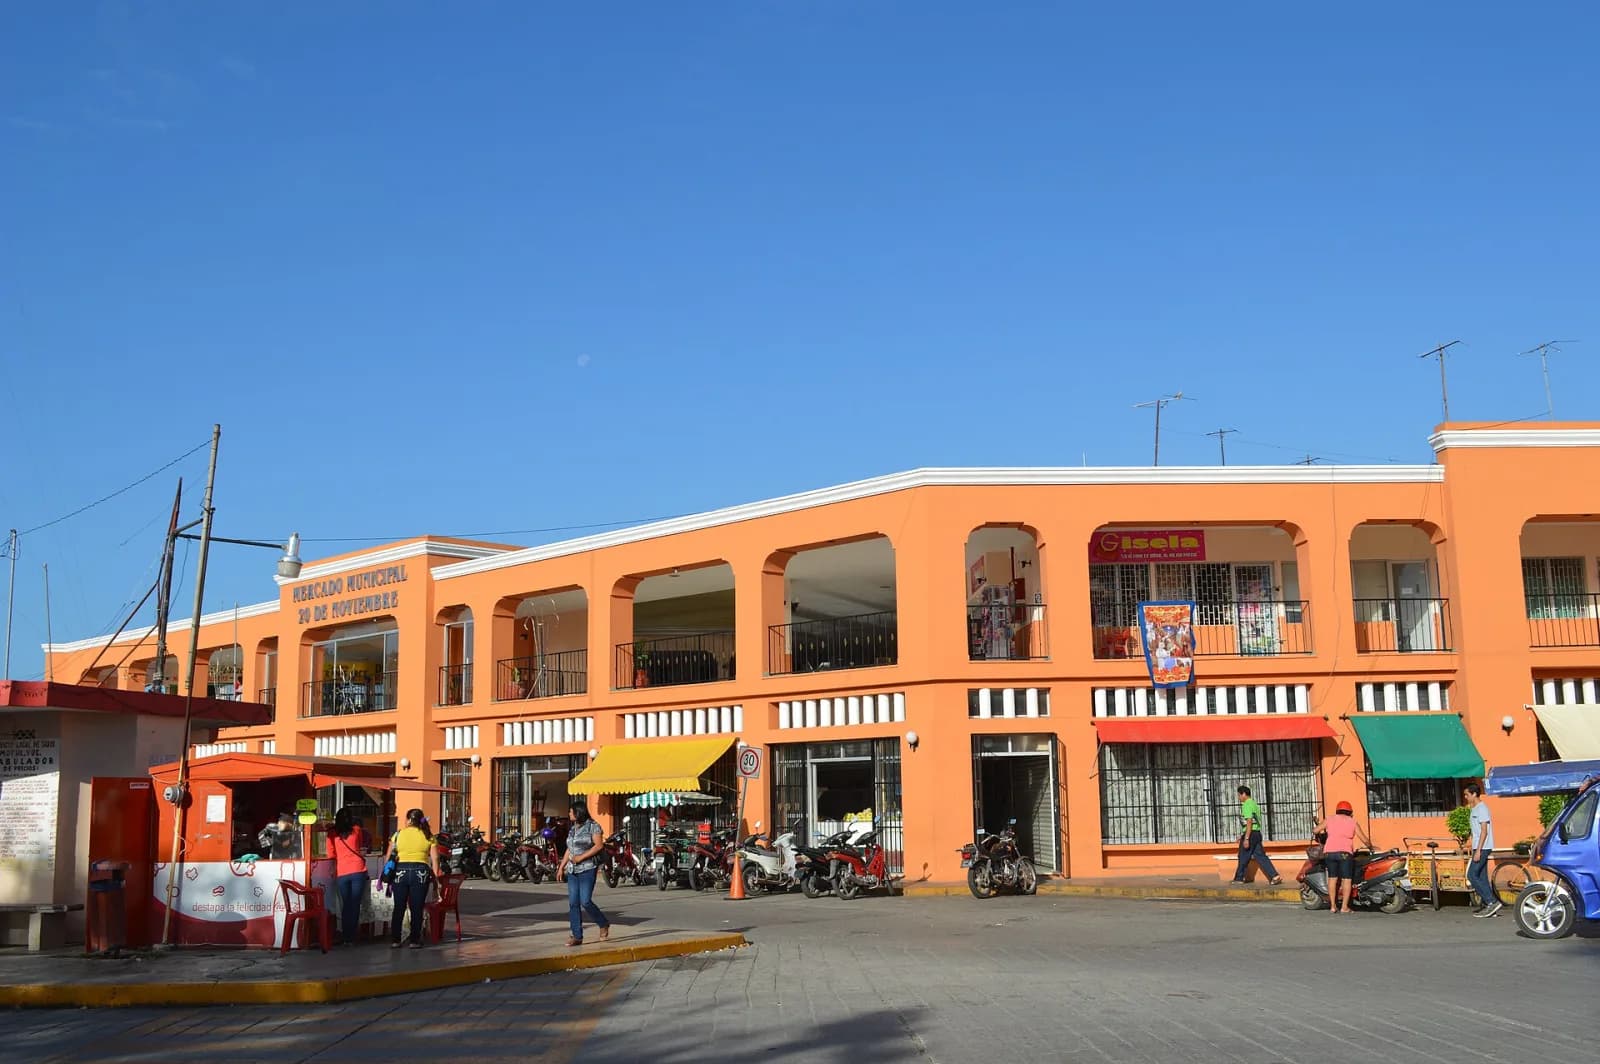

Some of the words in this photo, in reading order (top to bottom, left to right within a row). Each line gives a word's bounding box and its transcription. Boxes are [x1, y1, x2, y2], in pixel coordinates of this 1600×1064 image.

[1101, 532, 1200, 551] Gisela
[293, 578, 343, 603] MERCADO
[347, 564, 408, 592] MUNICIPAL
[298, 607, 311, 624] 20
[314, 604, 328, 621] DE
[332, 590, 399, 618] NOVIEMBRE
[744, 754, 754, 766] 30
[192, 902, 225, 913] destapa
[227, 902, 236, 911] la
[237, 902, 272, 912] felicidad
